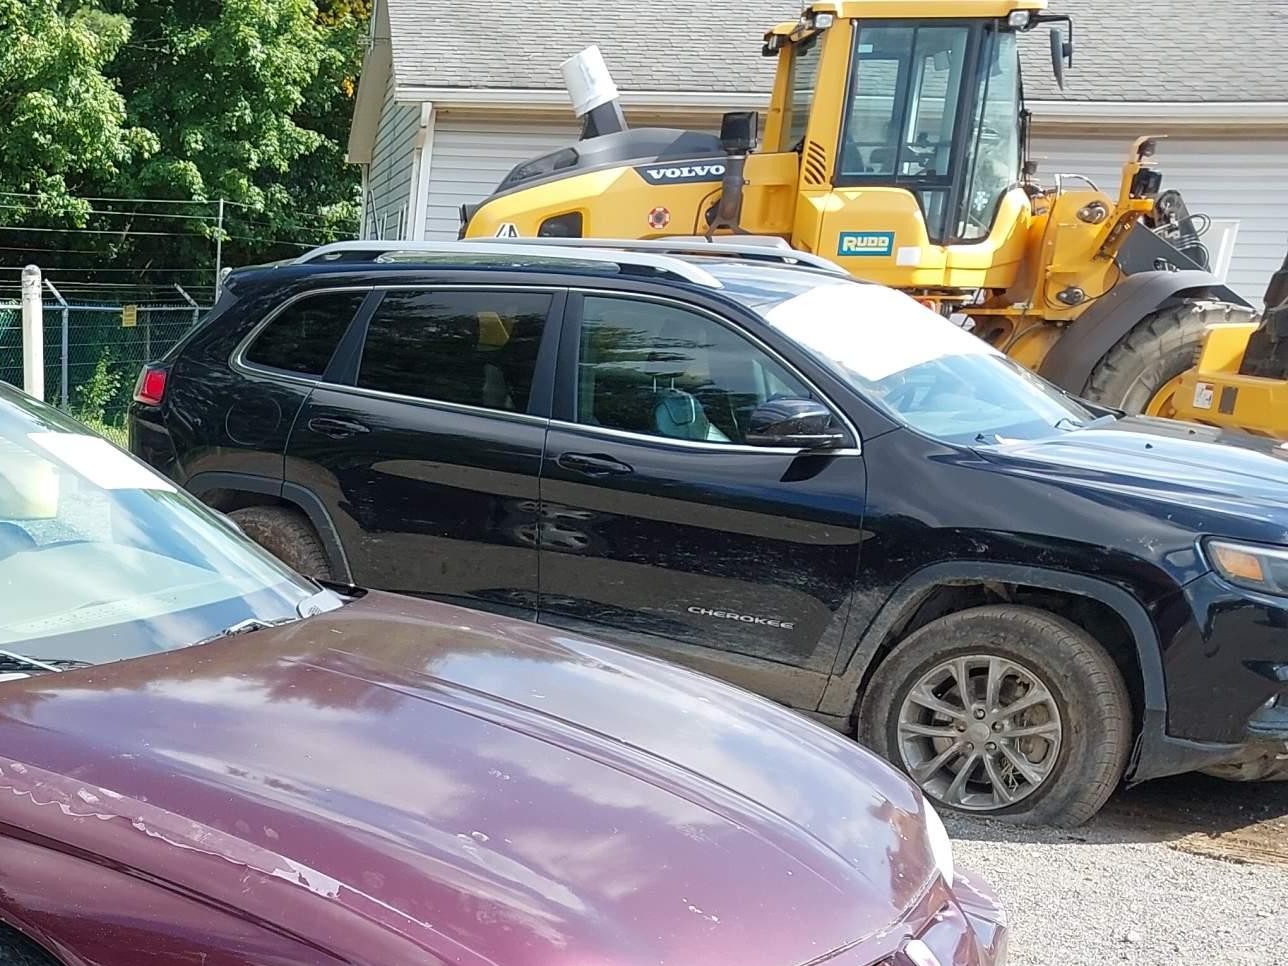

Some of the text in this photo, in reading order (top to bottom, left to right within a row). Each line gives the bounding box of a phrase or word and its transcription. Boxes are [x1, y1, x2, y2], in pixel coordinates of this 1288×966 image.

[647, 164, 726, 180] VOLVO
[842, 236, 890, 252] RUDD
[687, 606, 795, 629] CHEROKEE
